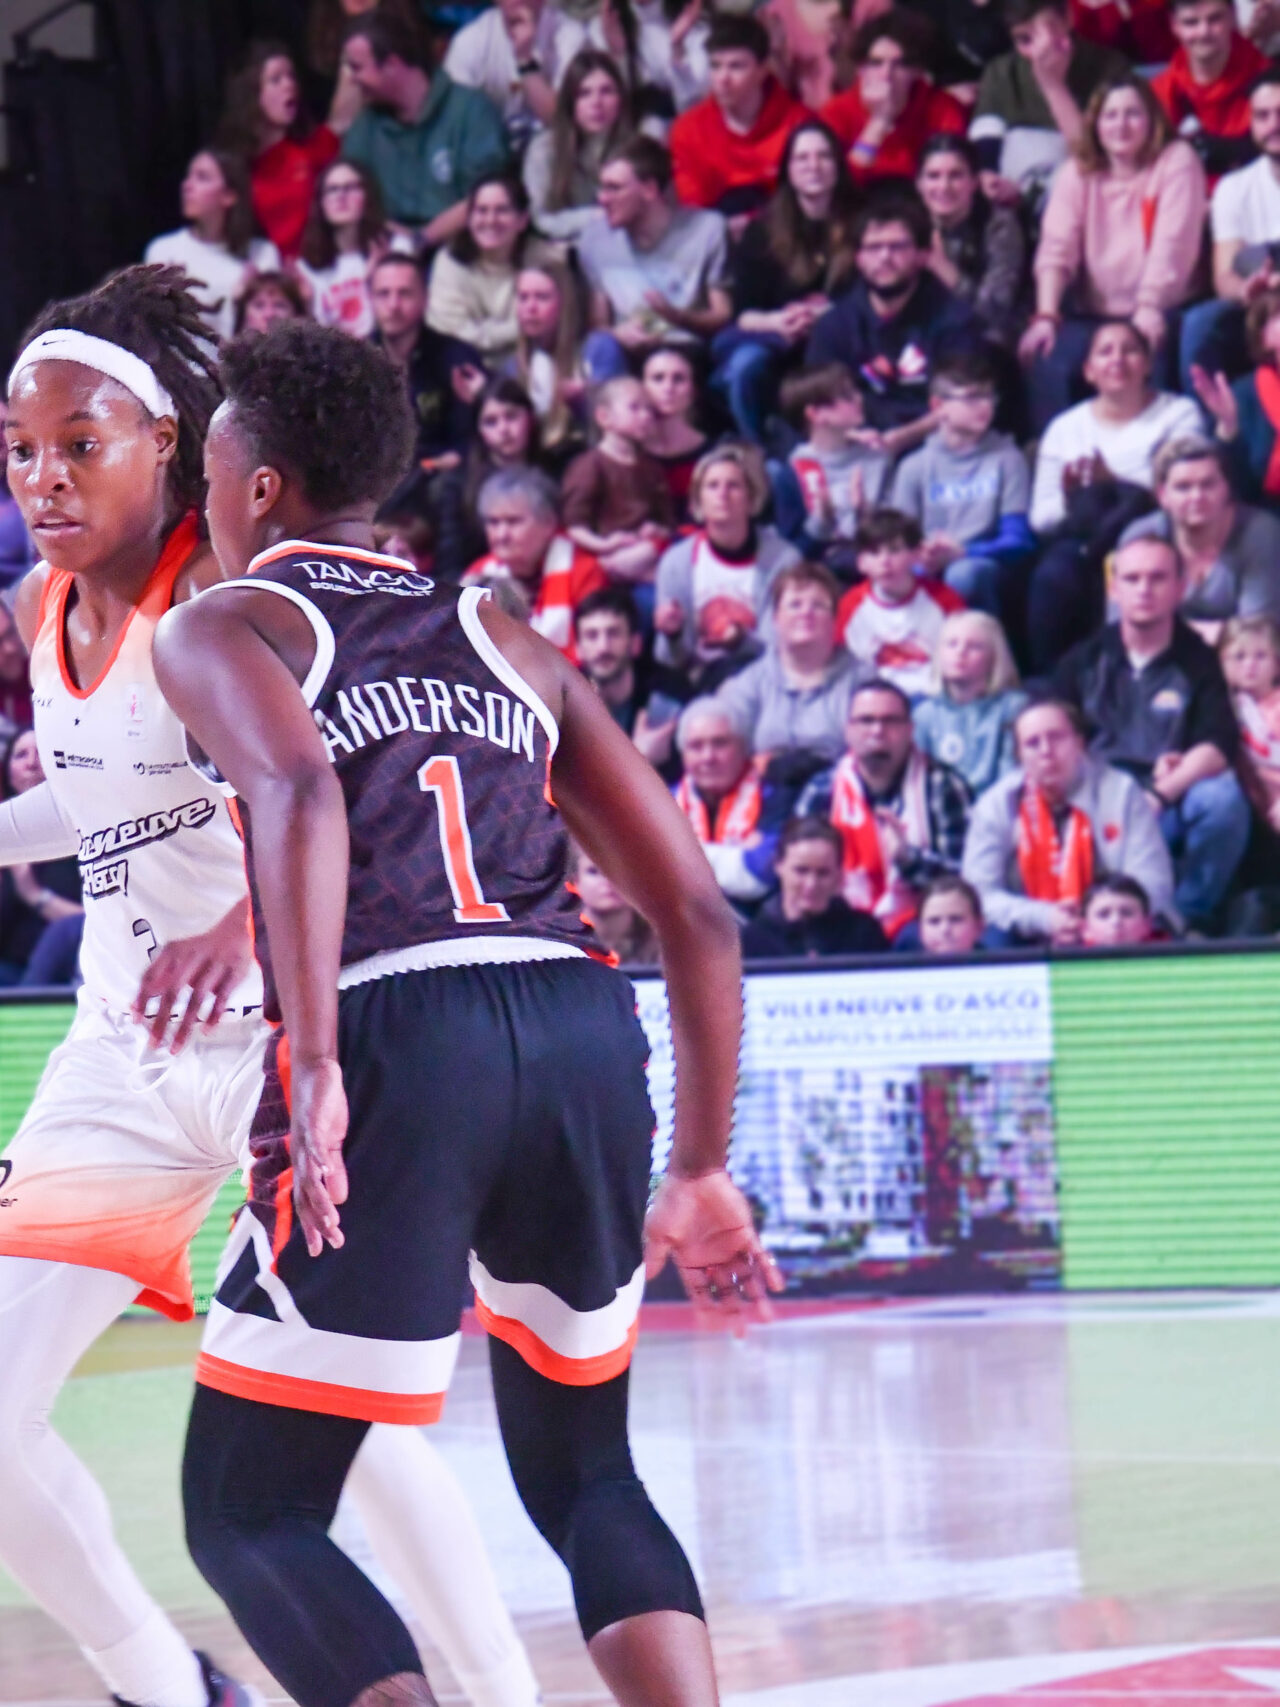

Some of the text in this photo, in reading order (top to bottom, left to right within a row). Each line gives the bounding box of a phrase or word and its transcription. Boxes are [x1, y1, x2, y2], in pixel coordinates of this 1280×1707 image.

[314, 676, 535, 763] ANDERSON
[417, 756, 512, 923] 1
[762, 988, 1040, 1019] VILLENEUVE D'ASCQ
